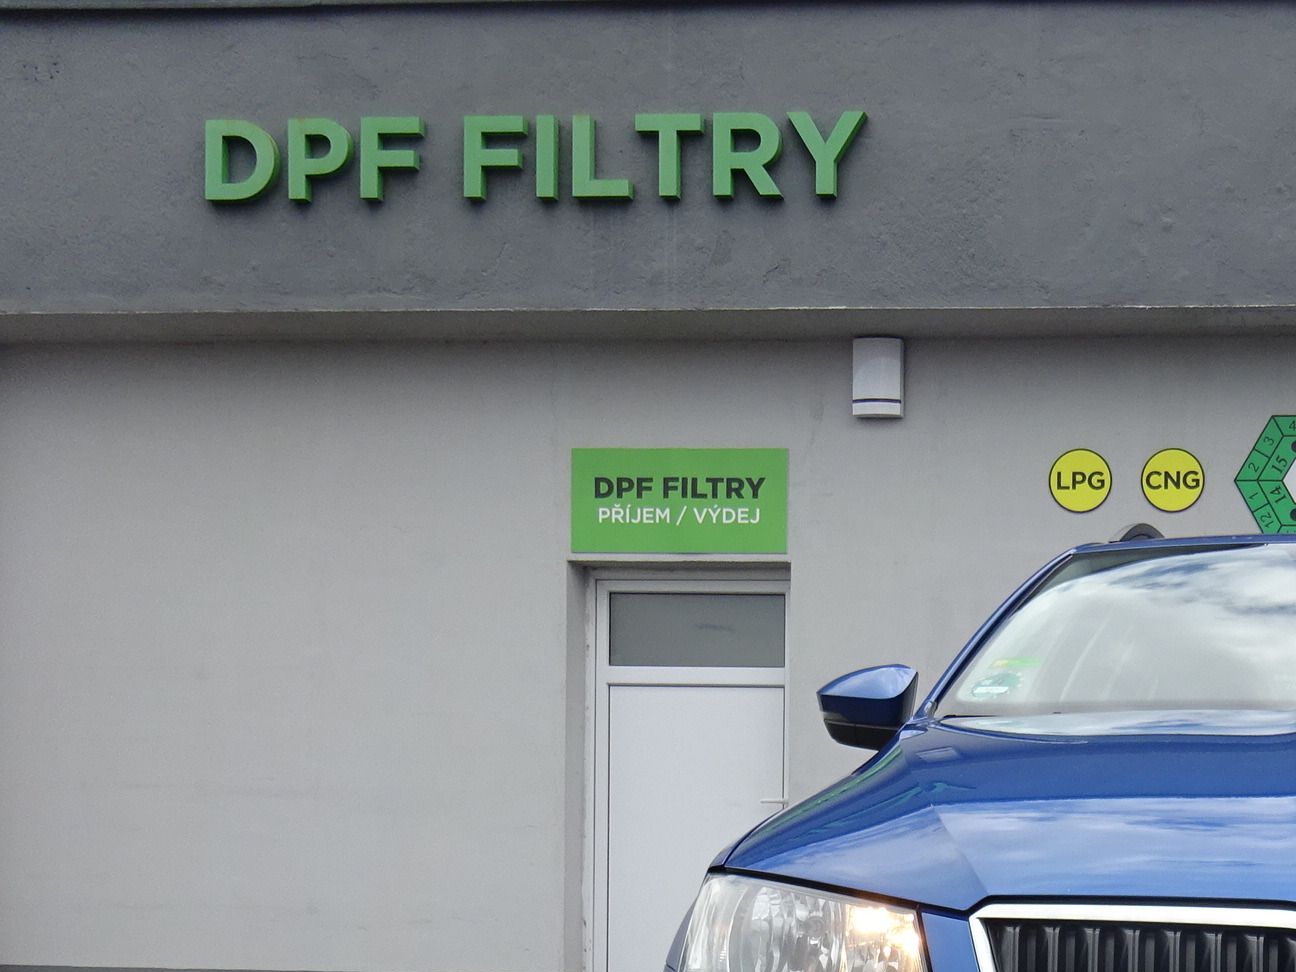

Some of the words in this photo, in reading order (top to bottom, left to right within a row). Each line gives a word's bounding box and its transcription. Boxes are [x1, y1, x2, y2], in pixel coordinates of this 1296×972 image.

[205, 116, 425, 201] DPF
[464, 111, 867, 199] FILTRY
[1288, 420, 1296, 432] 4
[1263, 435, 1275, 446] 3
[1248, 462, 1260, 473] 2
[1272, 455, 1288, 474] 15
[594, 477, 653, 499] DPF
[663, 477, 766, 499] FILTRY
[1056, 471, 1105, 491] LPG
[1145, 470, 1200, 491] CNG
[1269, 485, 1287, 504] 14
[598, 503, 670, 524] PŘÍJEM
[693, 503, 760, 524] VÝDEJ
[1260, 511, 1274, 529] 12
